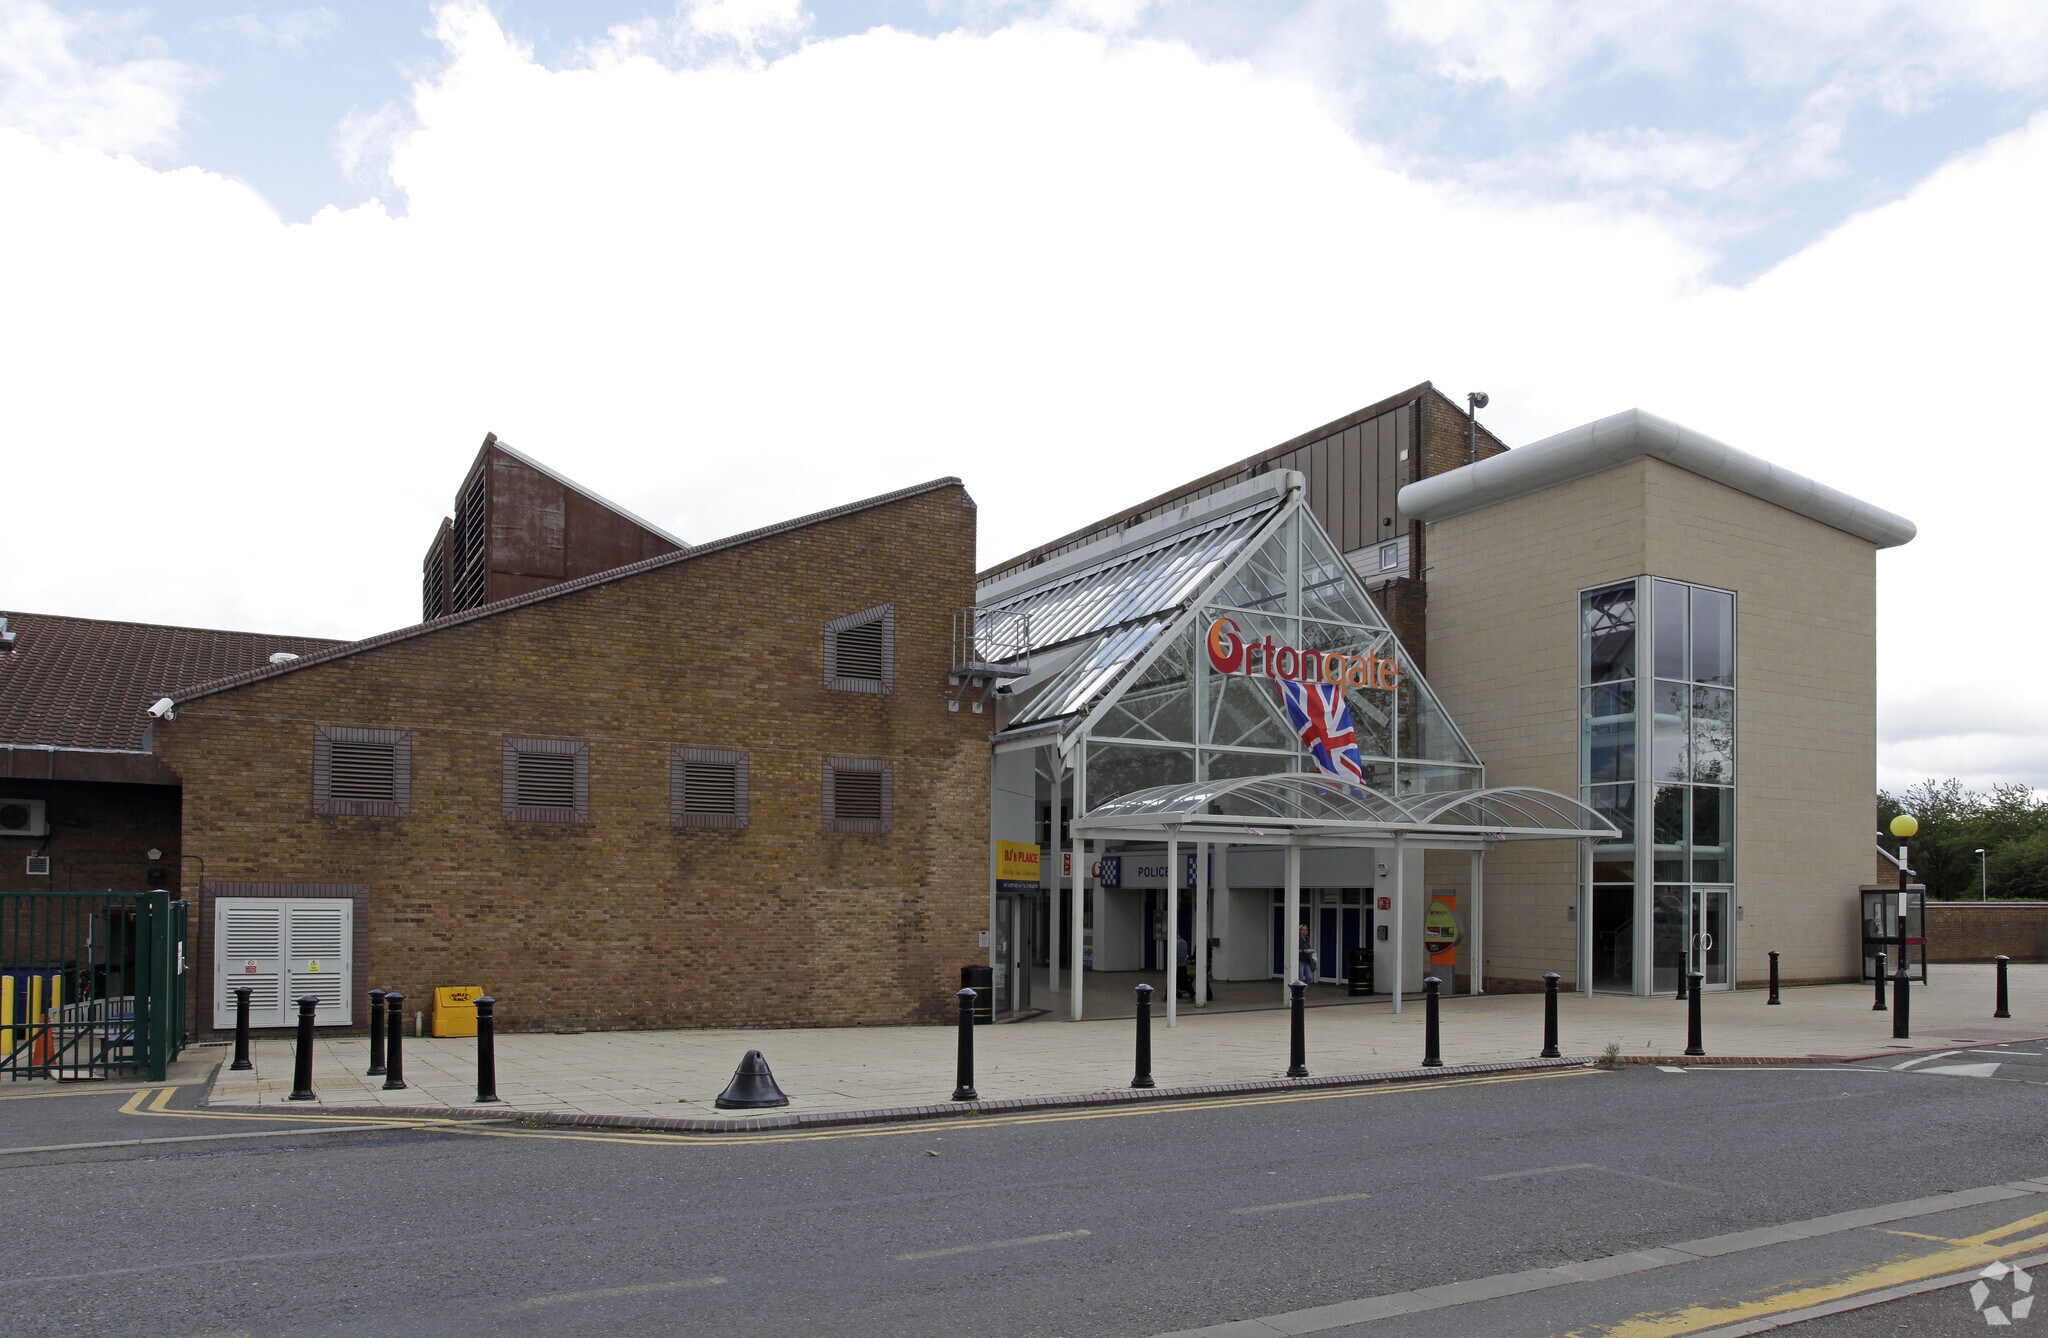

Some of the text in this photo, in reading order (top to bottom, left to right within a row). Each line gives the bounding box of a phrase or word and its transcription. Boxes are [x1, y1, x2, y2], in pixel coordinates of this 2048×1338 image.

[1207, 617, 1399, 697] Ortongate
[1004, 848, 1018, 862] BJ's
[1138, 866, 1169, 878] POLICE
